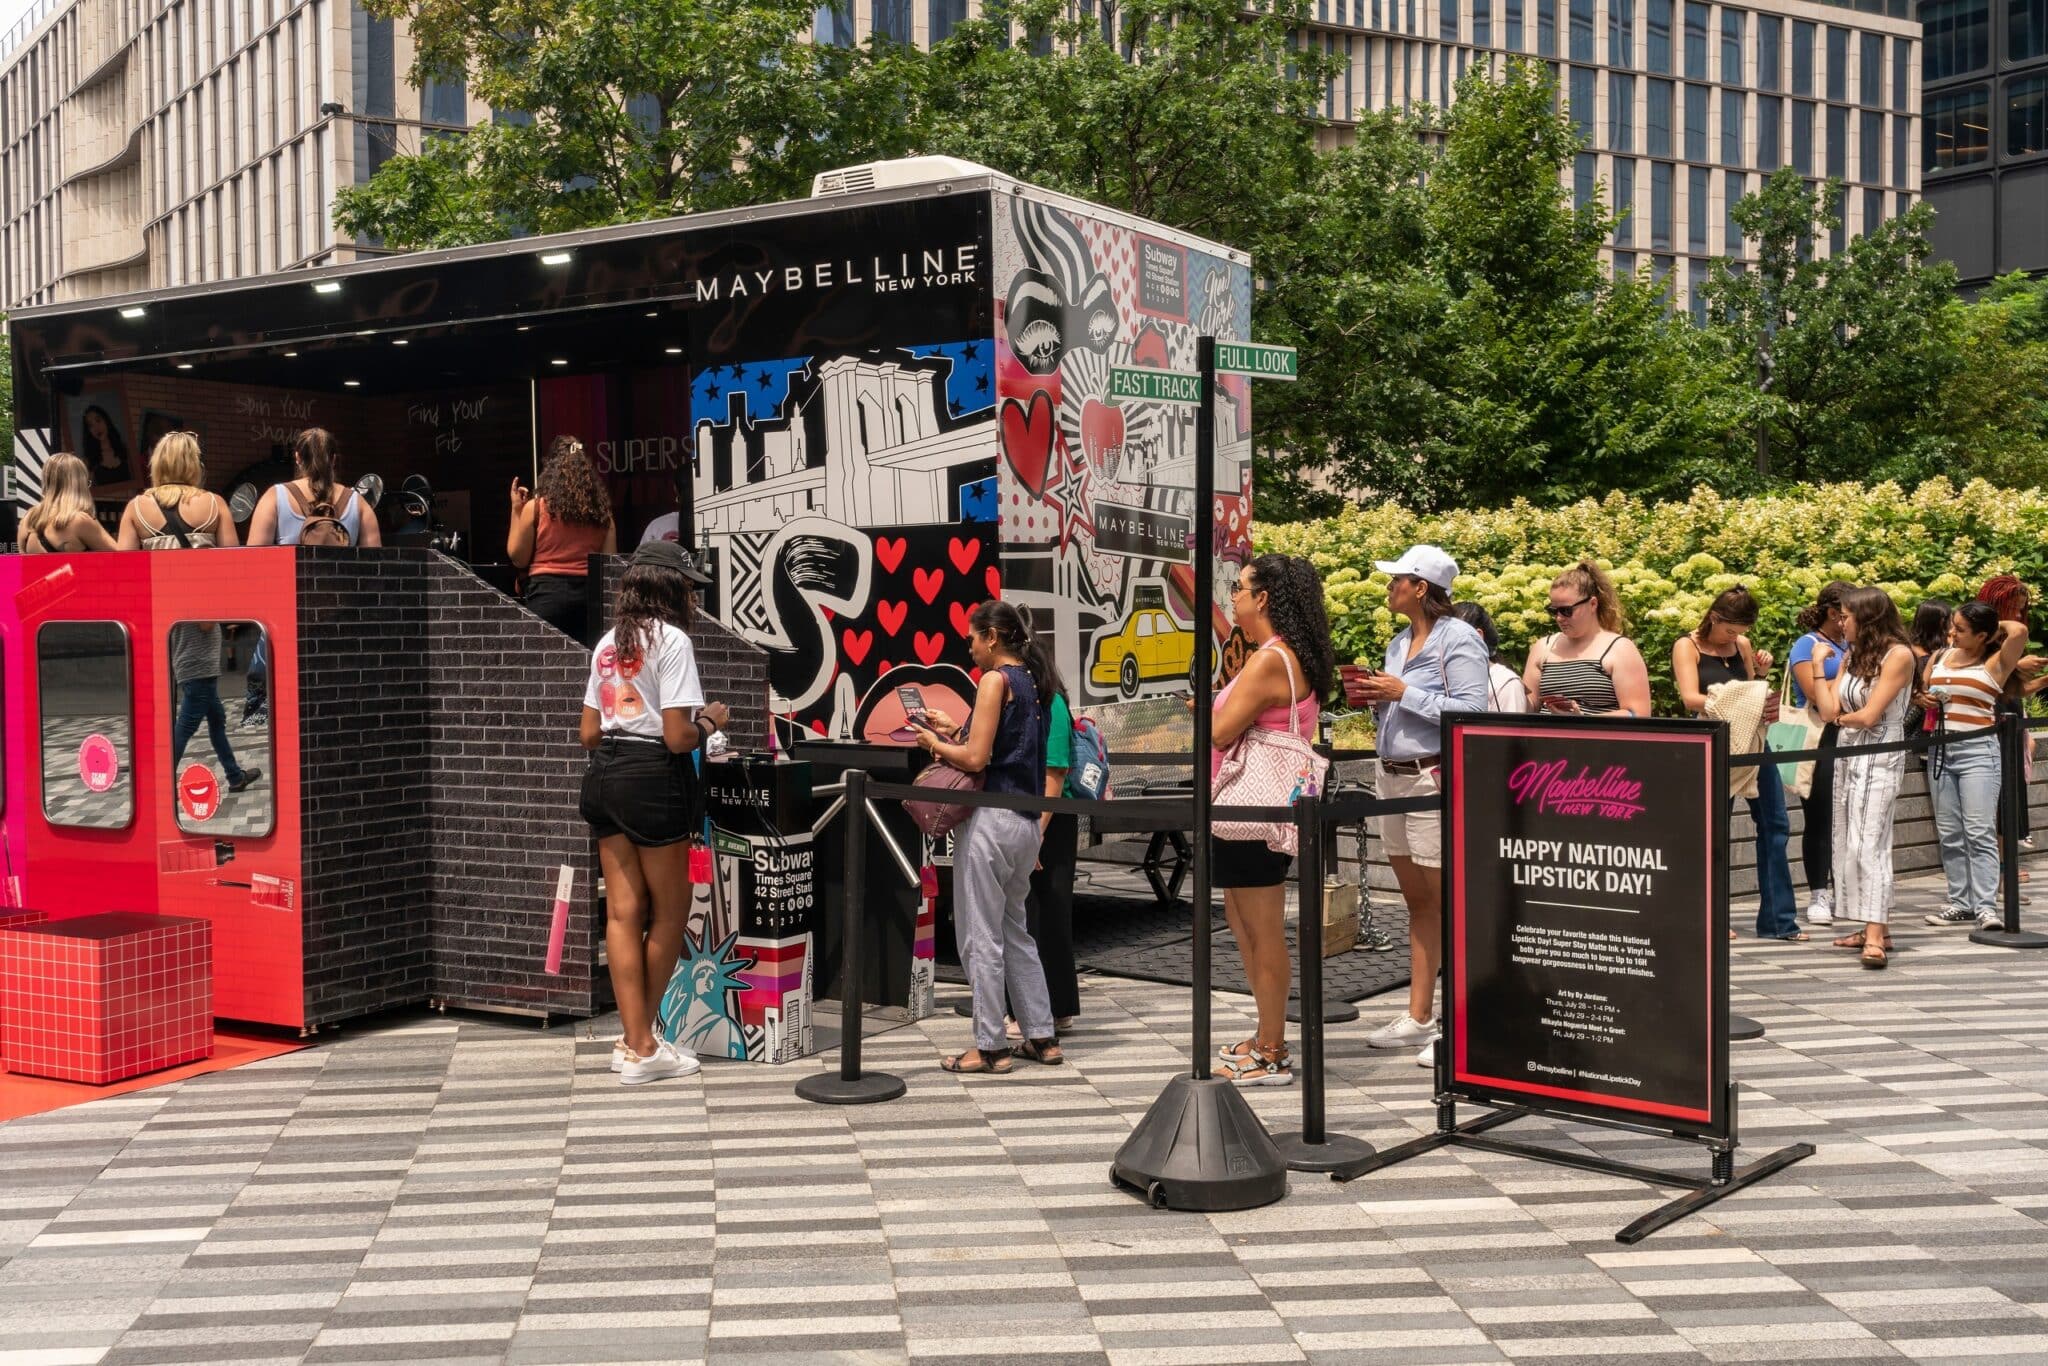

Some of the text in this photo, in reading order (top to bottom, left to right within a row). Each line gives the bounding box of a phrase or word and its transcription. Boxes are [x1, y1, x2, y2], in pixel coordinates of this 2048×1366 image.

[1145, 244, 1177, 271] Subway
[697, 245, 977, 301] MAYBELLINE
[875, 271, 975, 293] NEW YORK
[1219, 347, 1290, 373] FULL LOOK
[1114, 371, 1199, 399] FAST TRACK
[408, 401, 439, 427] Find
[1099, 516, 1185, 543] MAYBELLINE
[1170, 541, 1185, 549] YORK
[1509, 759, 1642, 813] Maybelline
[721, 798, 741, 806] NEW
[1562, 803, 1636, 819] NEW YORK
[1499, 837, 1668, 871] HAPPY NATIONAL
[754, 871, 812, 886] Times Square
[1513, 863, 1652, 896] LIPSTICK DAY!
[754, 886, 767, 897] 42
[770, 885, 794, 899] Street
[756, 901, 763, 910] A
[768, 902, 775, 911] C
[780, 902, 785, 911] E
[756, 914, 803, 927] S 1 2 3 7
[1511, 934, 1536, 944] Lipstick
[1537, 936, 1552, 947] Day!
[1553, 938, 1571, 948] Super
[1572, 940, 1587, 950] Stay
[1588, 942, 1607, 951] Matte
[1608, 944, 1619, 953] Ink
[1627, 946, 1644, 957] Vinyl
[1645, 948, 1656, 957] Ink
[1516, 924, 1650, 946] Celebrate your favorite shade this National
[1512, 954, 1656, 978] longwear gorgeousness in two great finishes.
[1519, 945, 1534, 953] both
[1535, 947, 1549, 956] give
[1571, 952, 1590, 960] much
[1616, 955, 1625, 965] Up
[1558, 989, 1567, 997] Art
[1568, 990, 1575, 999] by
[1563, 1010, 1576, 1019] July
[1603, 1015, 1614, 1023] PM
[1565, 1001, 1578, 1009] July
[1604, 1005, 1615, 1013] PM
[1563, 1031, 1576, 1040] July
[1603, 1036, 1614, 1044] PM
[1588, 1024, 1603, 1032] Meet
[1536, 1063, 1573, 1075] @maybelline
[1578, 1070, 1641, 1087] #NationalLipstickDay
